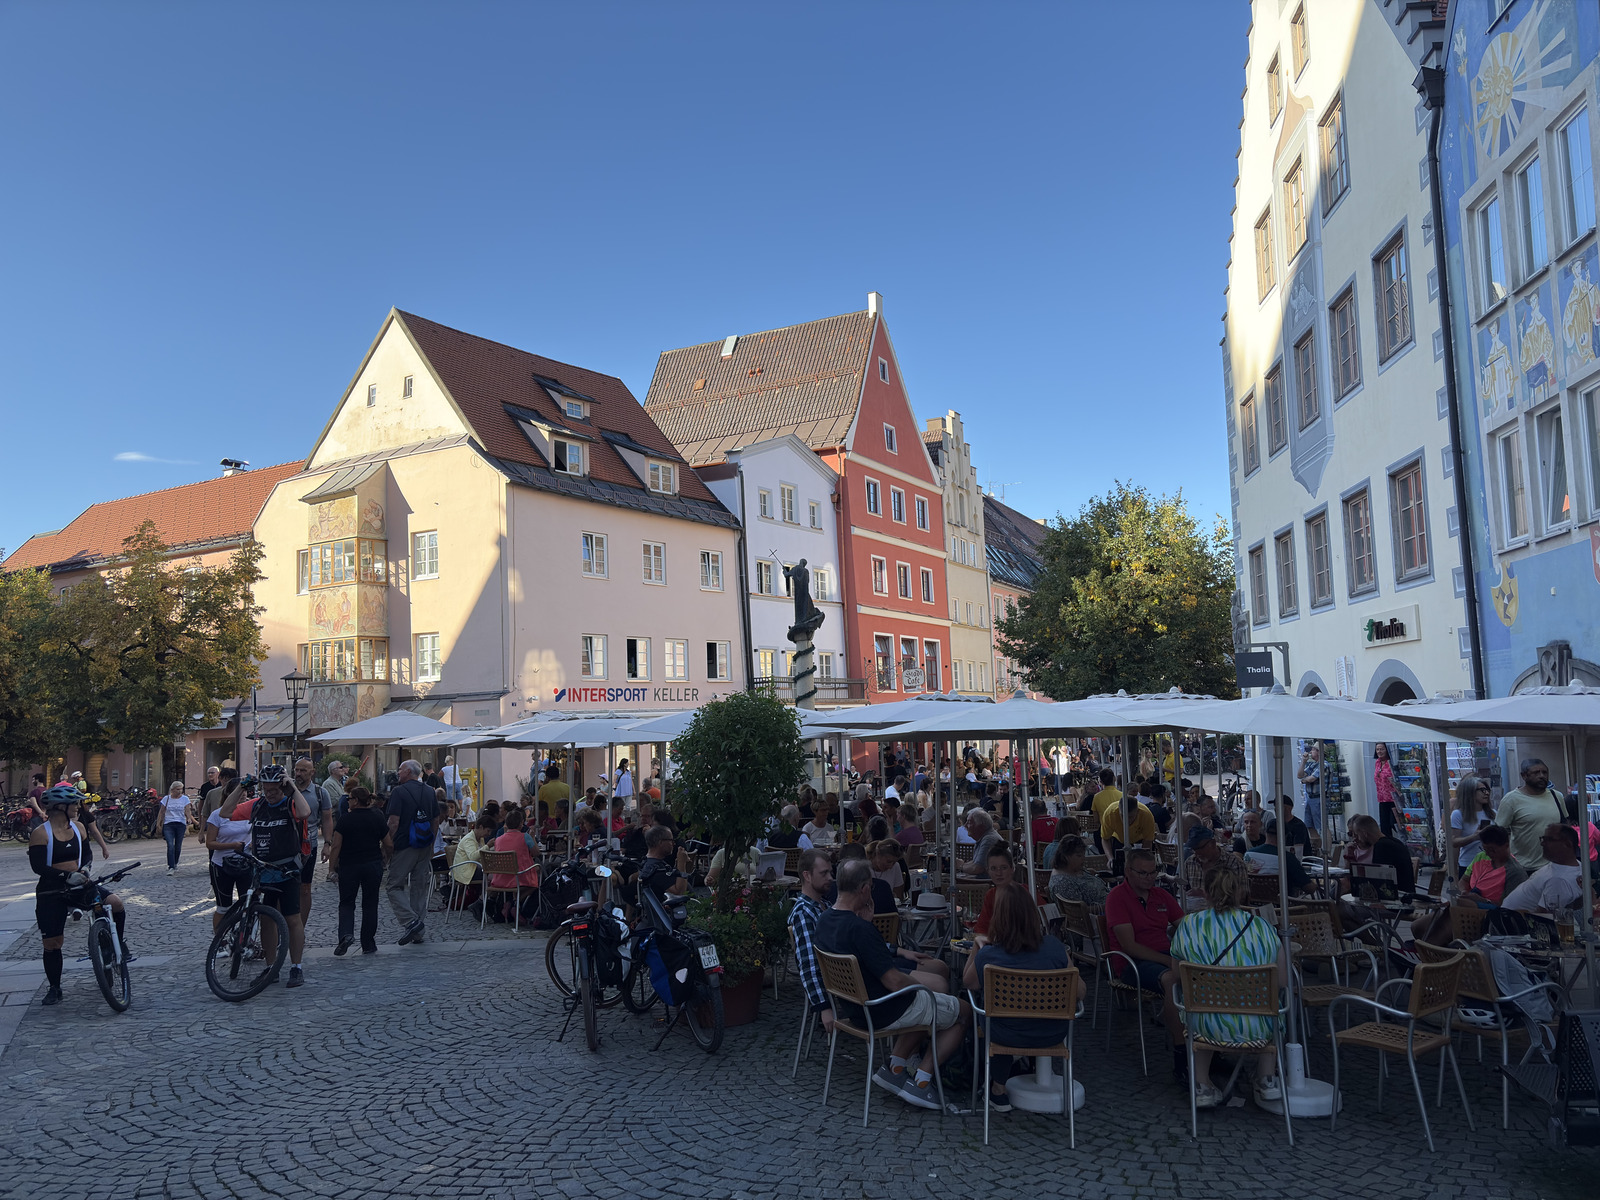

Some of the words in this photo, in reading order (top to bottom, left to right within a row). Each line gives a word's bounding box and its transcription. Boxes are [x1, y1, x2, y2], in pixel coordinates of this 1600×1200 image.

[1374, 618, 1405, 640] Thalia
[568, 687, 647, 702] INTERSPORT
[654, 687, 699, 702] KELLER
[255, 819, 287, 827] CUBE
